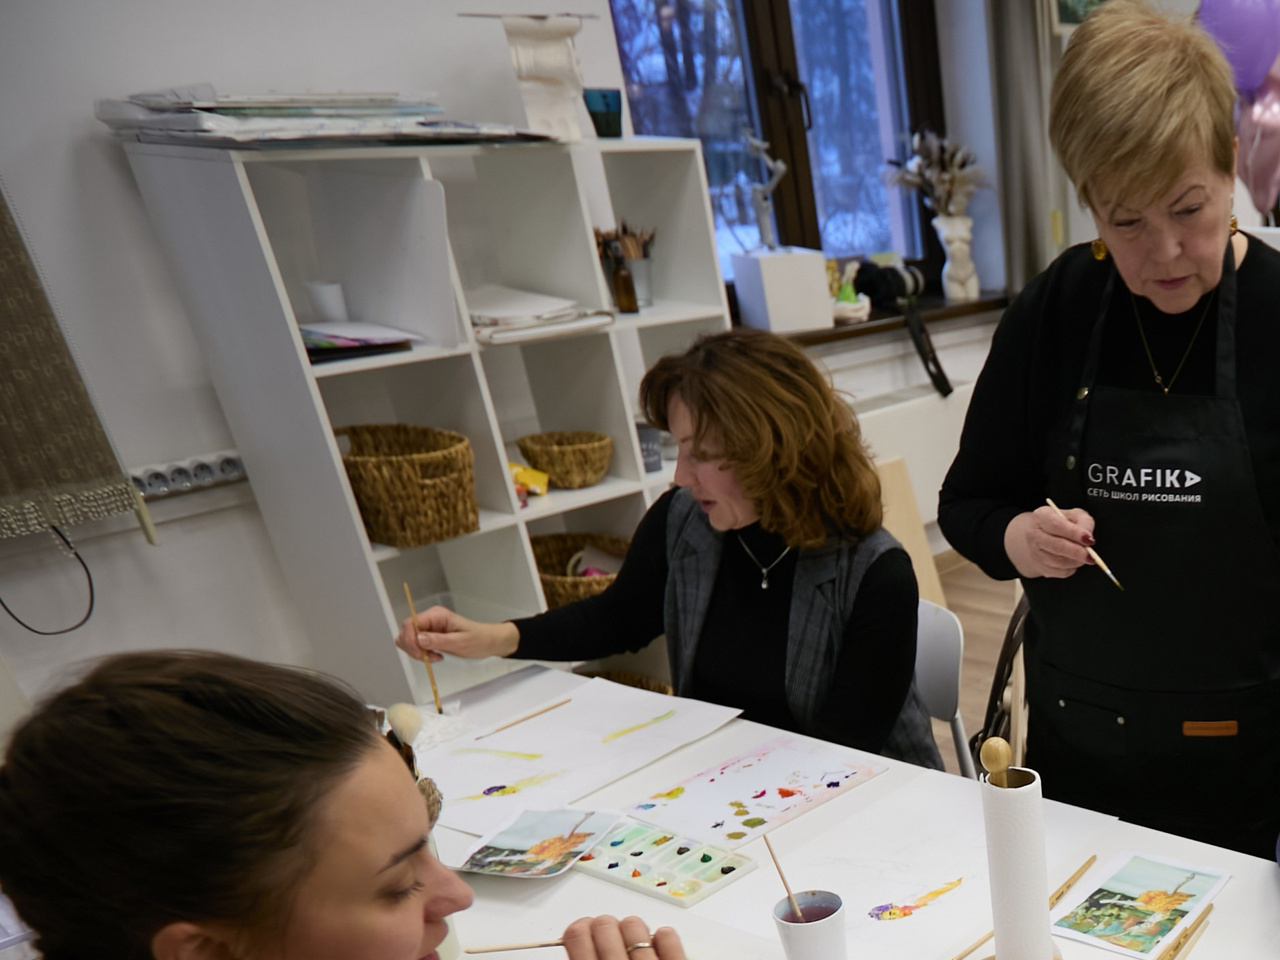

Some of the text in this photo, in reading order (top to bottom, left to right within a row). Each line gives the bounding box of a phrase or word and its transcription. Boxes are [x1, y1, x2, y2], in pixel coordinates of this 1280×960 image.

[1087, 487, 1202, 503] СЕТЬ ШКОЛ РИСОВАНИЯ
